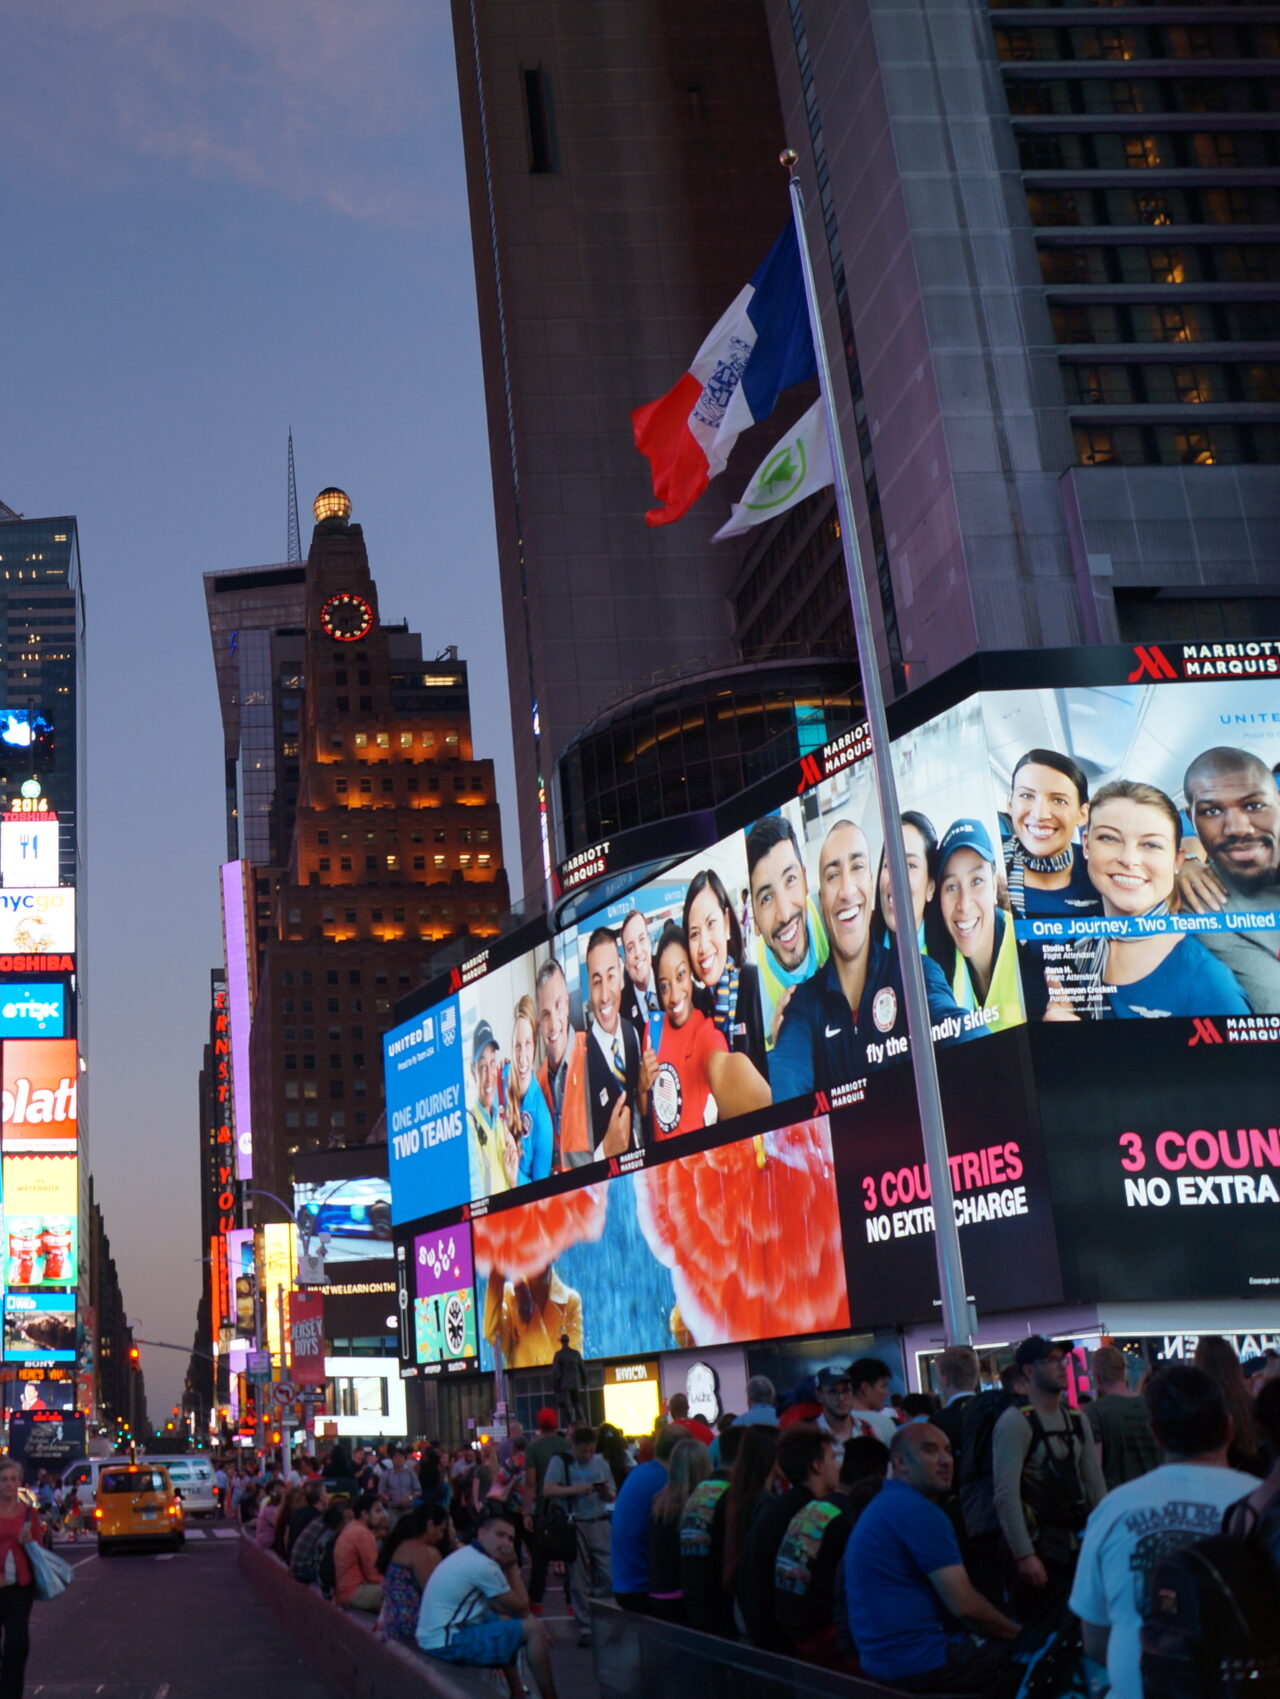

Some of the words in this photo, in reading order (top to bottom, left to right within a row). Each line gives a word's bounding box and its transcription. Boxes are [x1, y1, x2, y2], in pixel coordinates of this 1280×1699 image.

[1186, 659, 1278, 675] MARQUIS
[1220, 713, 1280, 725] UNITE
[823, 722, 869, 759] MARRIOT
[825, 737, 872, 774] MARQUIS
[3, 811, 57, 821] TOSHIBA
[11, 798, 48, 812] 2016
[562, 842, 610, 875] MARRIOTT
[563, 860, 605, 889] MARQUIS
[1033, 921, 1063, 935] One
[1068, 919, 1132, 935] Journey.
[1135, 917, 1167, 931] Two
[1170, 915, 1222, 930] Teams.
[1226, 913, 1275, 928] United
[461, 949, 490, 972] MARRIOTT
[462, 963, 487, 983] MARQUIS
[388, 1029, 423, 1057] UNITED
[866, 1042, 884, 1063] fly
[885, 1036, 908, 1057] the
[964, 1004, 1000, 1032] skies
[214, 993, 230, 1102] ERNST
[831, 1078, 868, 1098] MARRIOTT
[832, 1091, 865, 1108] MARQUIS
[392, 1109, 412, 1132] ONE
[414, 1083, 460, 1121] JOURNEY
[392, 1129, 420, 1161] TWO
[421, 1110, 463, 1149] TEAMS
[619, 1149, 646, 1163] MARRIOTT
[1119, 1131, 1146, 1172] 3
[620, 1159, 644, 1171] MARQUIS
[862, 1176, 878, 1212] 3
[880, 1141, 1023, 1208] COUTRIES
[1124, 1177, 1171, 1207] NO
[1176, 1174, 1280, 1206] EXTRA
[866, 1216, 891, 1243] NO
[893, 1207, 936, 1237] EXTR
[955, 1186, 1028, 1227] CHARGE
[331, 1285, 344, 1295] WE
[344, 1283, 370, 1295] LEARN
[370, 1283, 383, 1293] ON
[291, 1318, 323, 1340] JERSEY
[294, 1337, 319, 1356] BOYS
